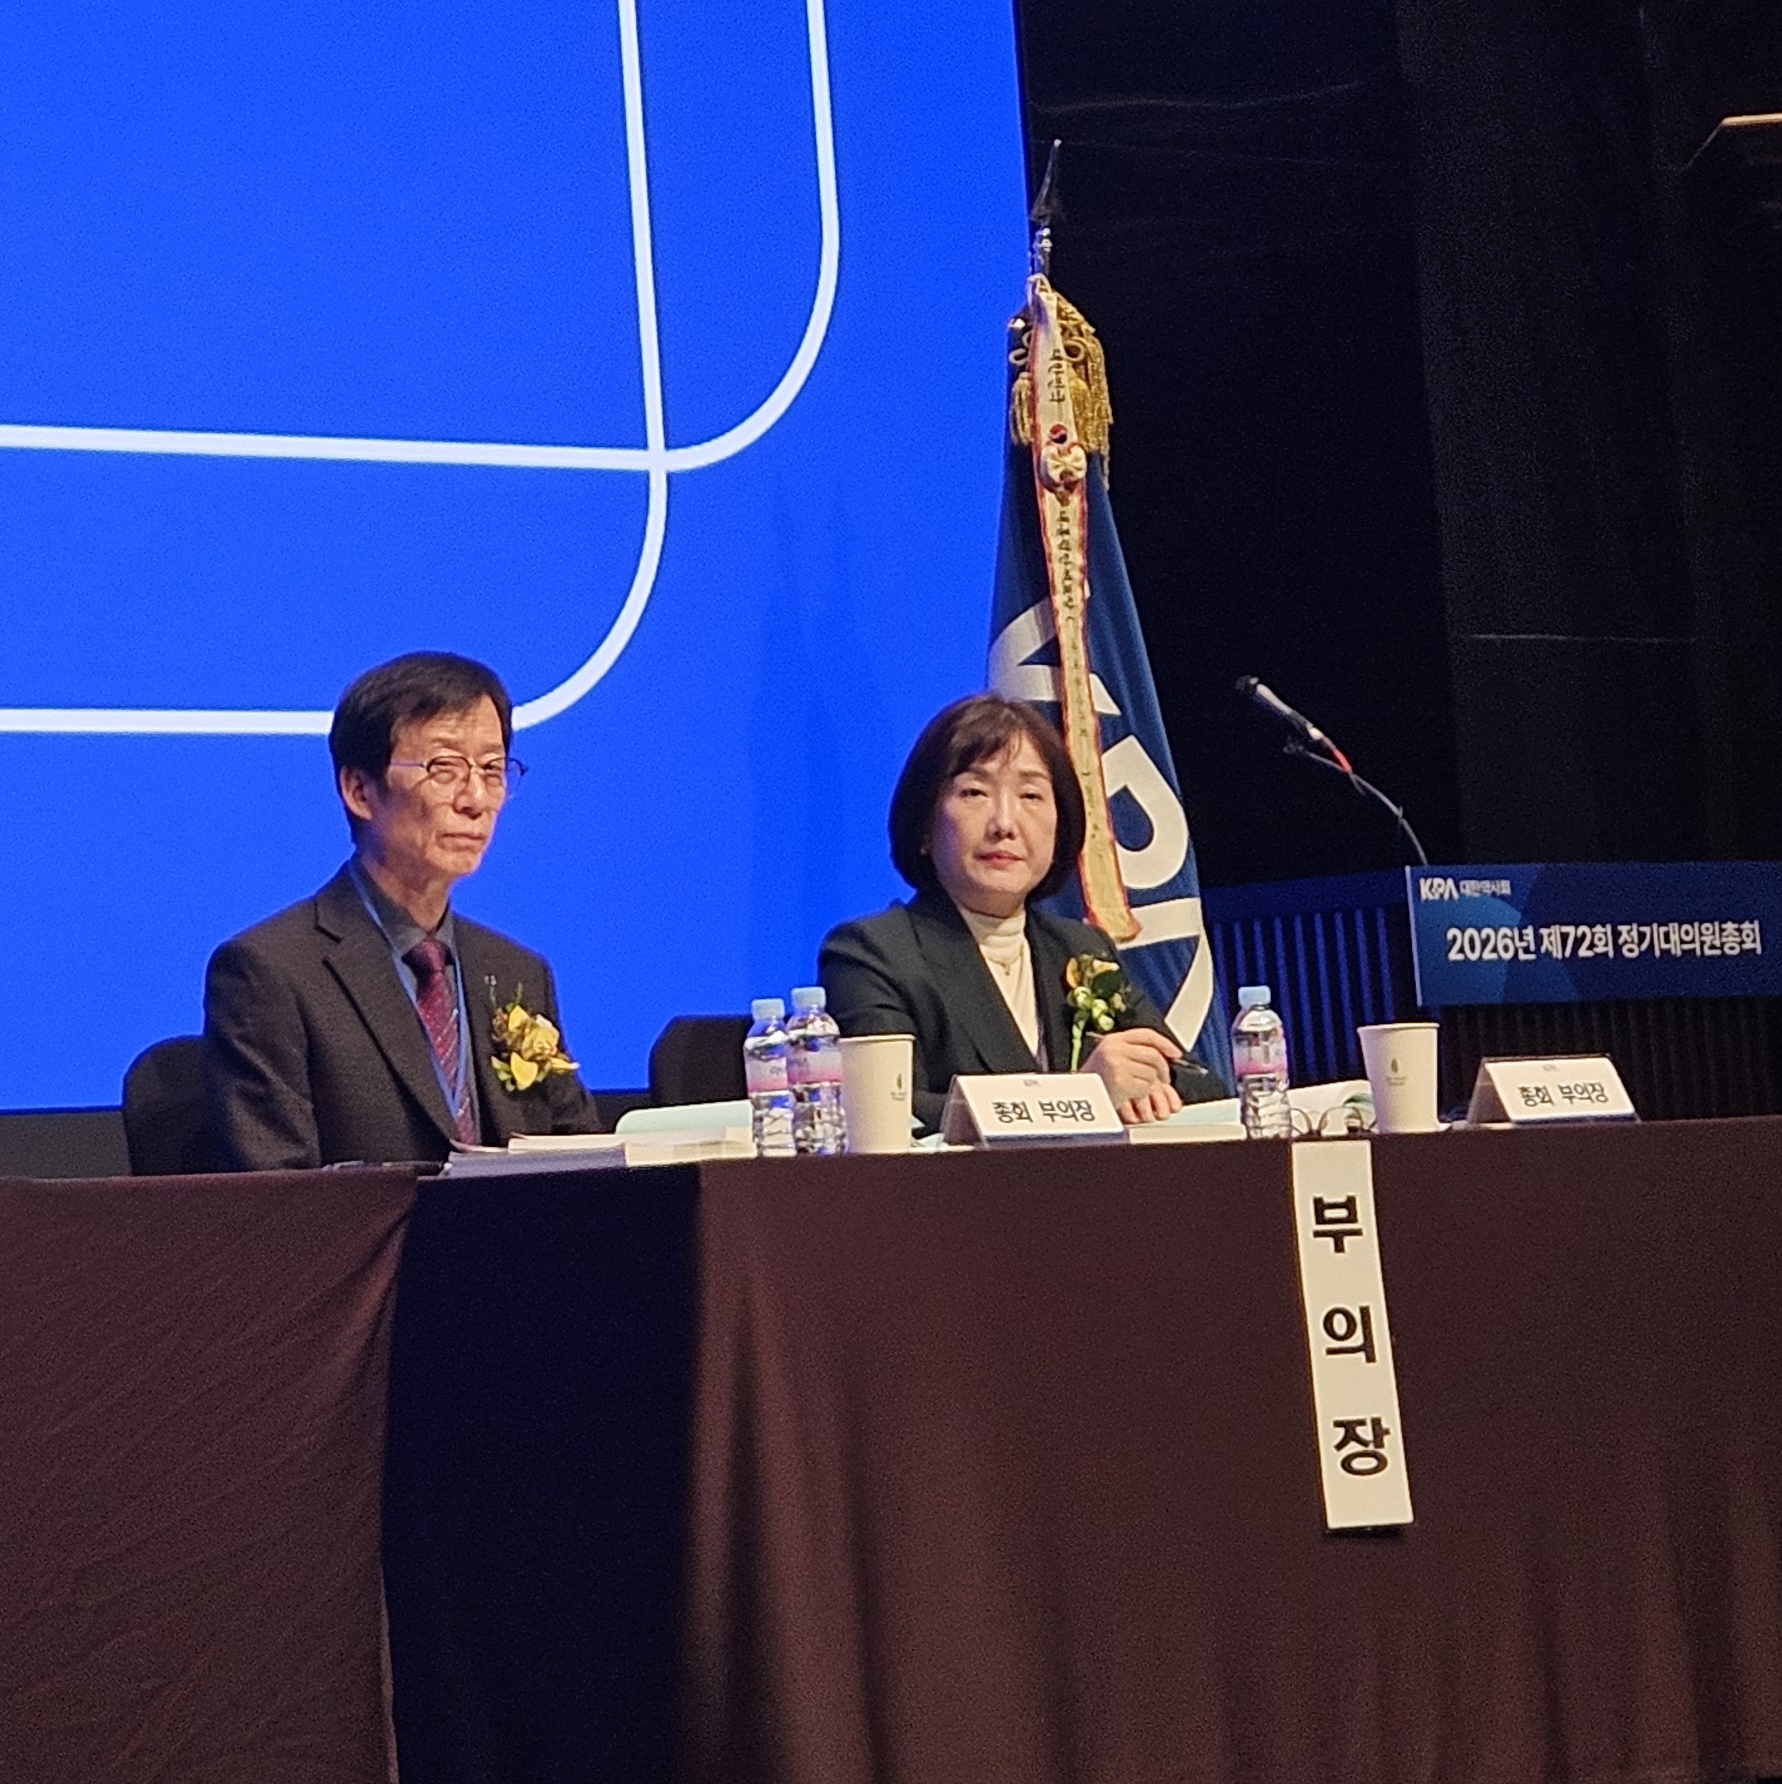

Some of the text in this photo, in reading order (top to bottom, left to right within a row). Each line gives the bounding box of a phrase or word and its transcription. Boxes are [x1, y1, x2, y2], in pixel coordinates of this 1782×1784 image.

[1419, 877, 1460, 901] KPA
[1446, 919, 1762, 961] 2026년 제72회 정기대의원총회
[1517, 1081, 1609, 1107] 총회 부의장
[991, 1099, 1096, 1124] 총회 부의장
[1312, 1194, 1391, 1477] 부의장
